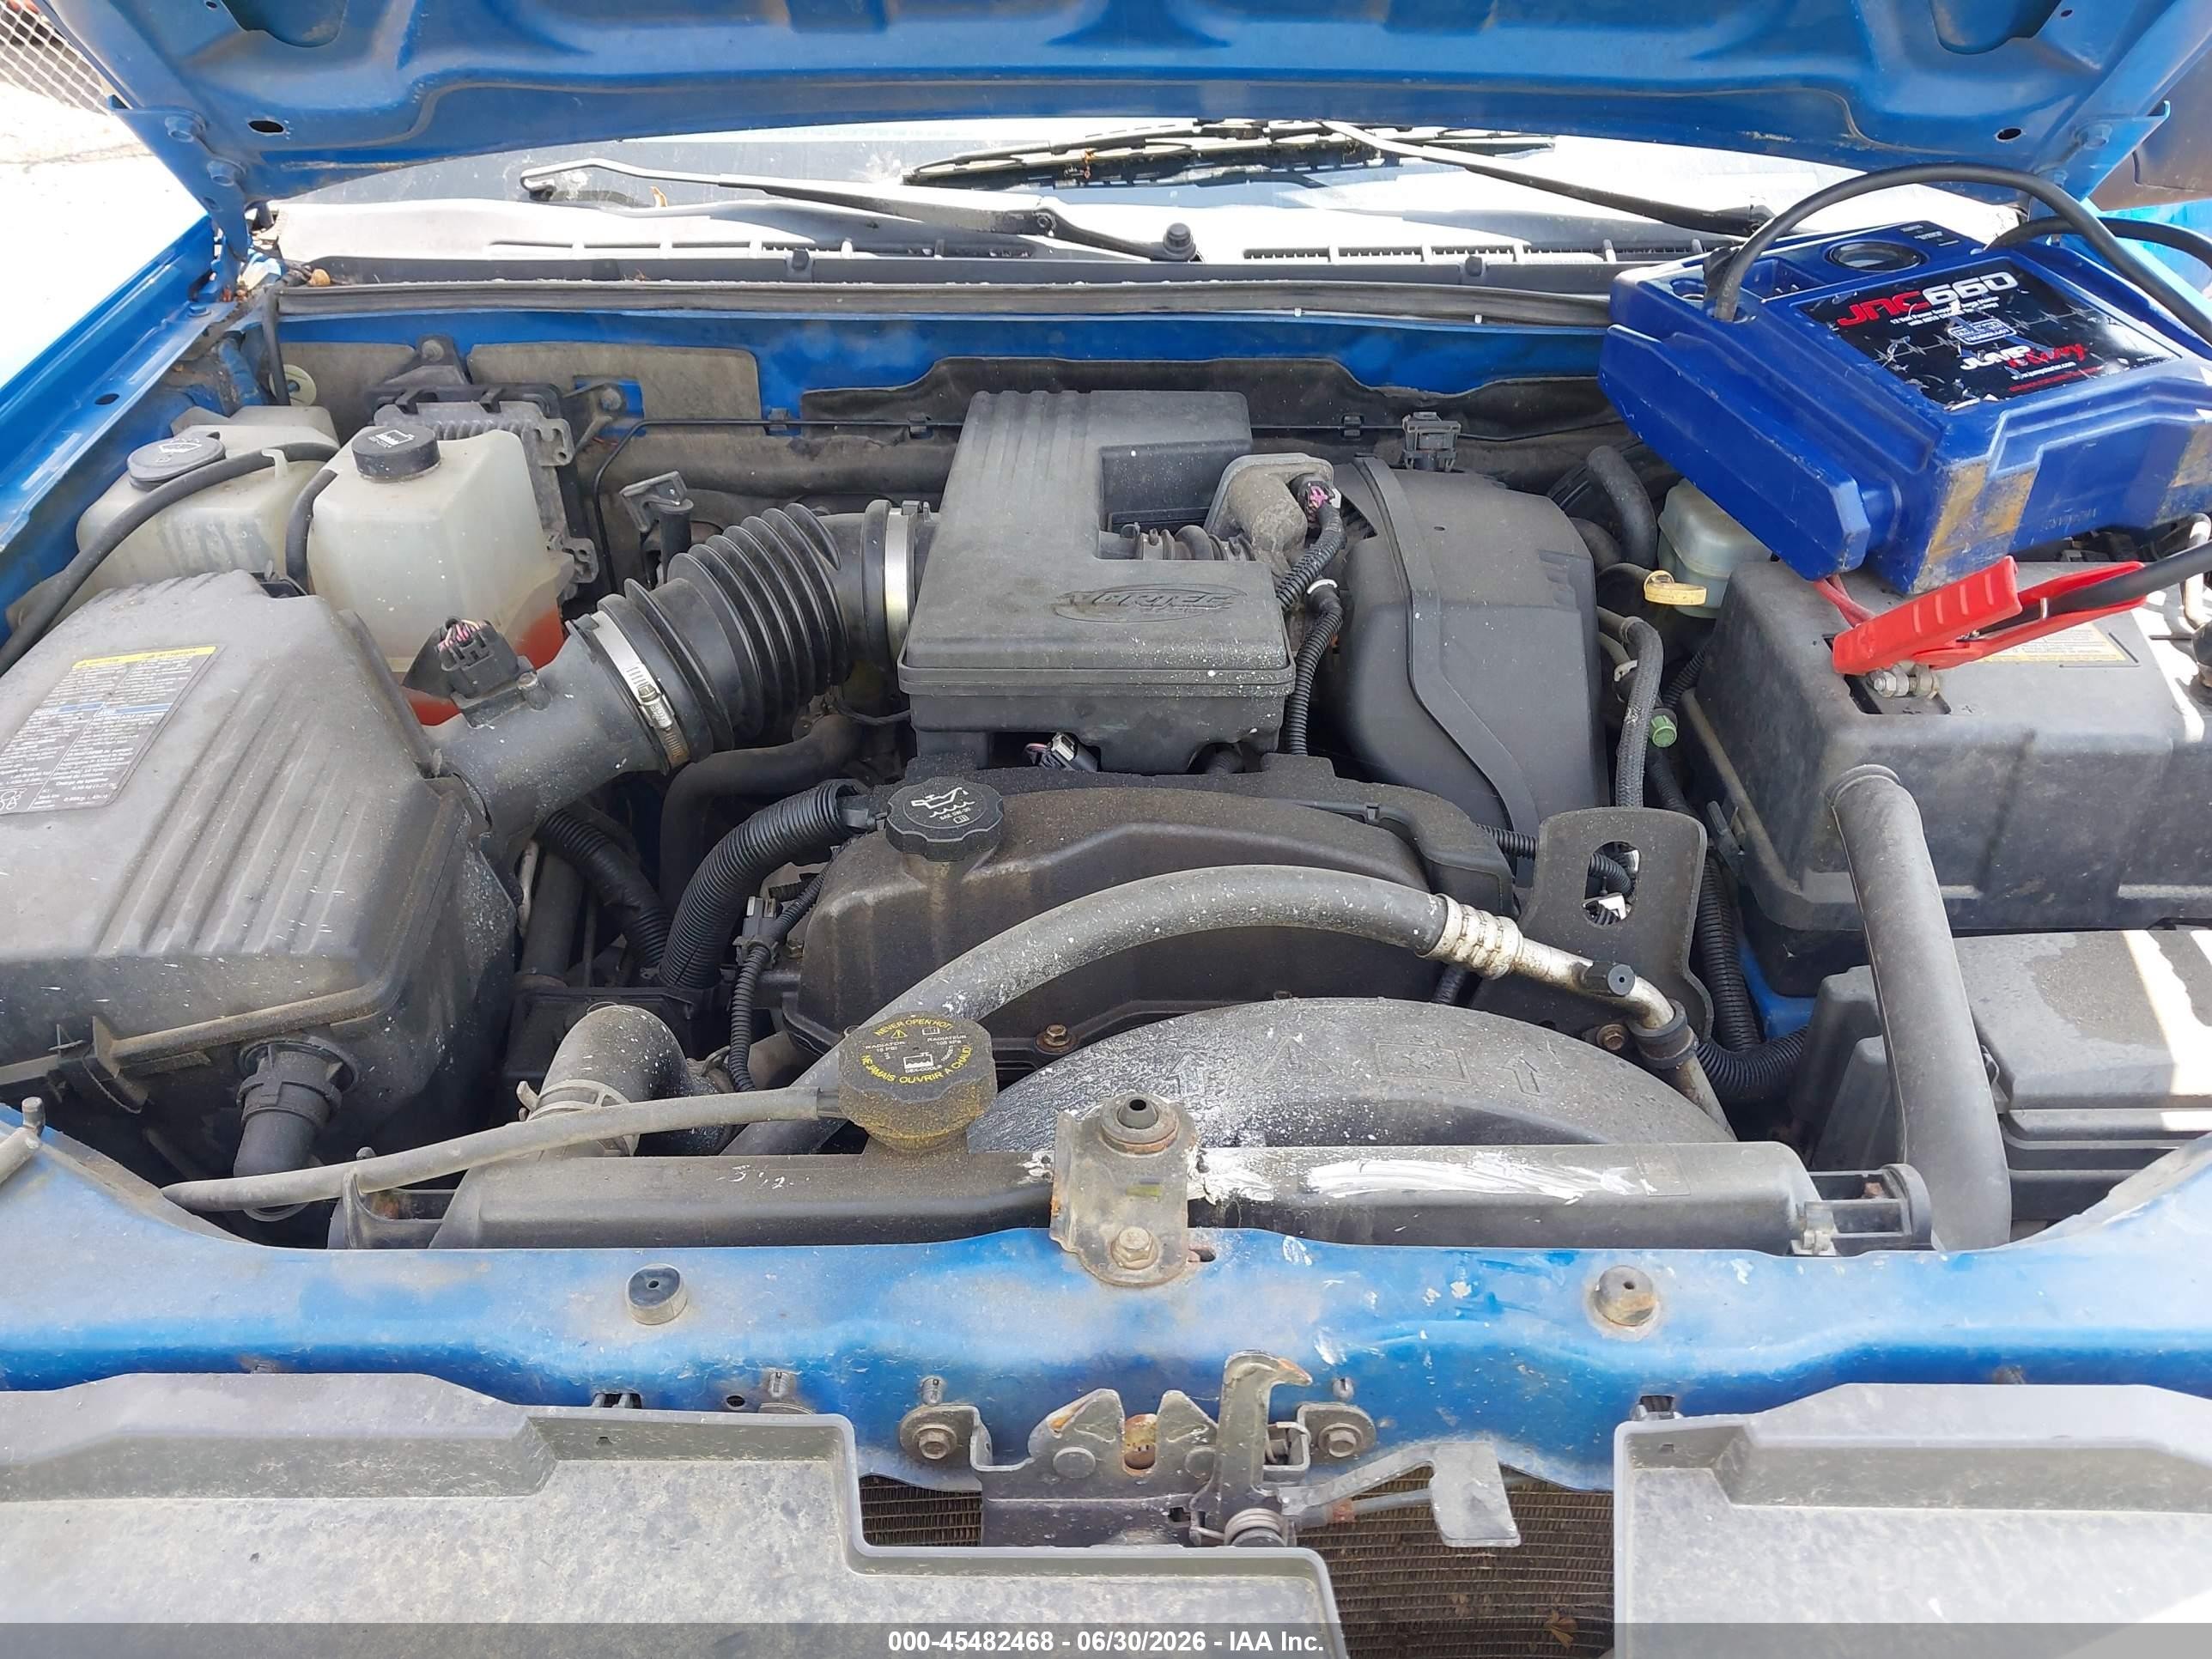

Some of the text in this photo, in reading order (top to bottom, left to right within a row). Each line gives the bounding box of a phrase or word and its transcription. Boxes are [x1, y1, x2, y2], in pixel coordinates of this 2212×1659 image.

[1838, 271, 2018, 326] JNC660
[873, 1018, 954, 1036] NEVER OPEN HOT!
[865, 1041, 905, 1049] RADIATOR
[860, 1054, 873, 1066] NE
[866, 1065, 896, 1082] JAMAIS
[899, 1072, 944, 1084] OUVRIR
